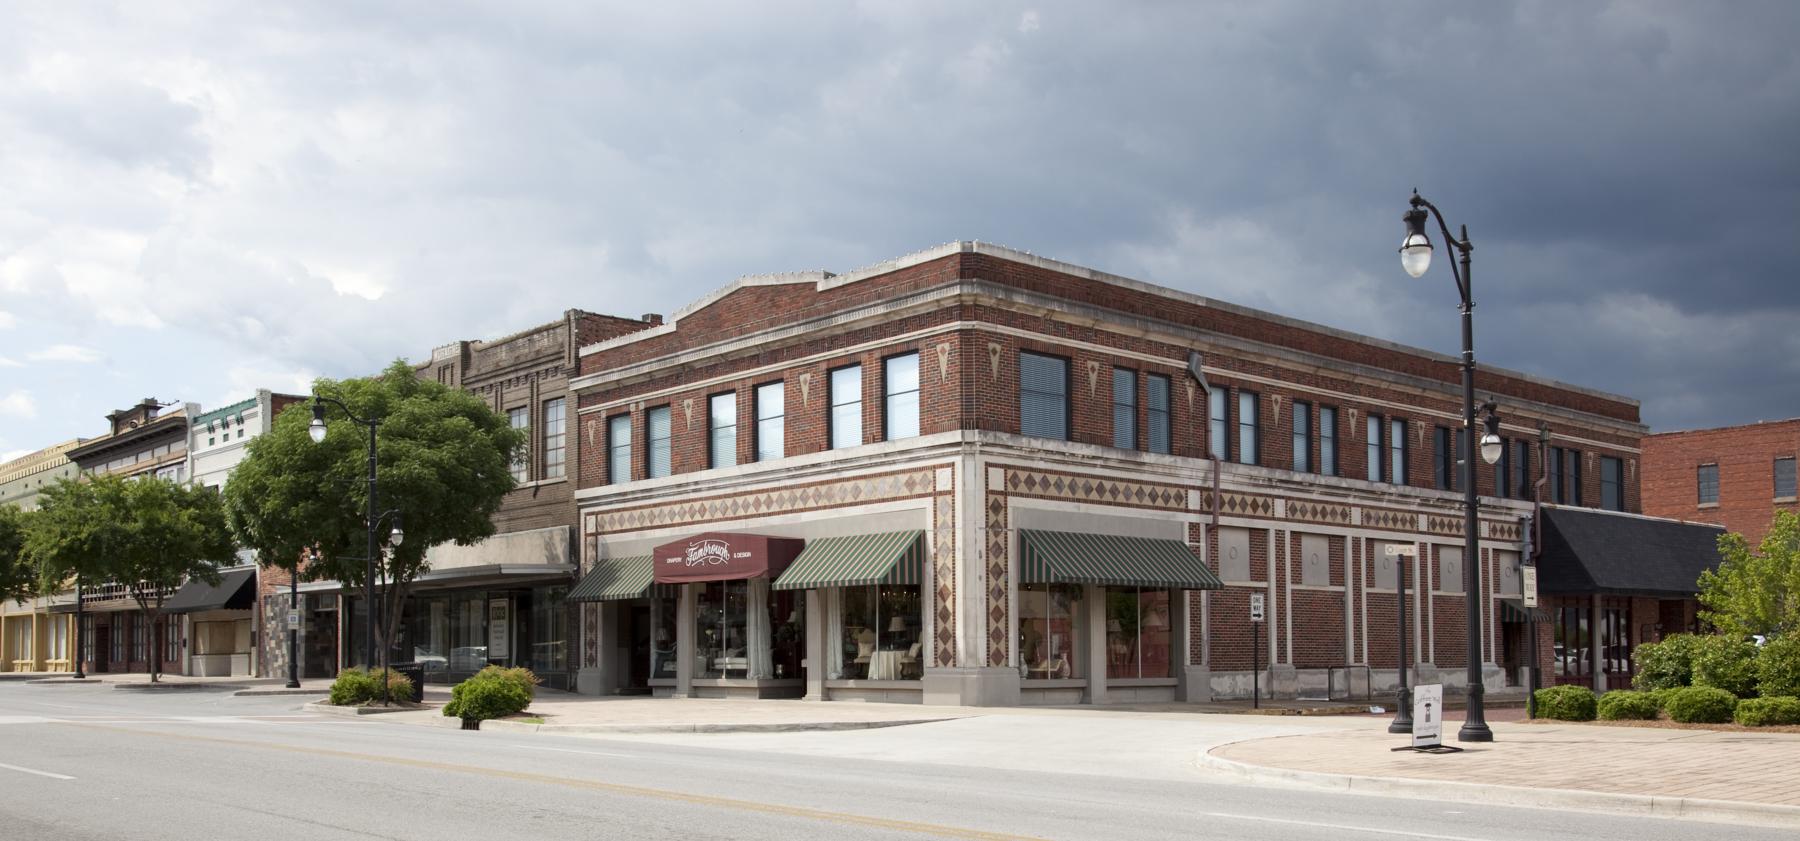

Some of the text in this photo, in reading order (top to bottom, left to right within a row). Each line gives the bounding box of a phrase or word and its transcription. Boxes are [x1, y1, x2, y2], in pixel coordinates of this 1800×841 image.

[685, 540, 730, 566] Fambrough
[1525, 572, 1535, 581] ONE
[1252, 596, 1262, 604] ONE
[1252, 604, 1262, 612] WAY
